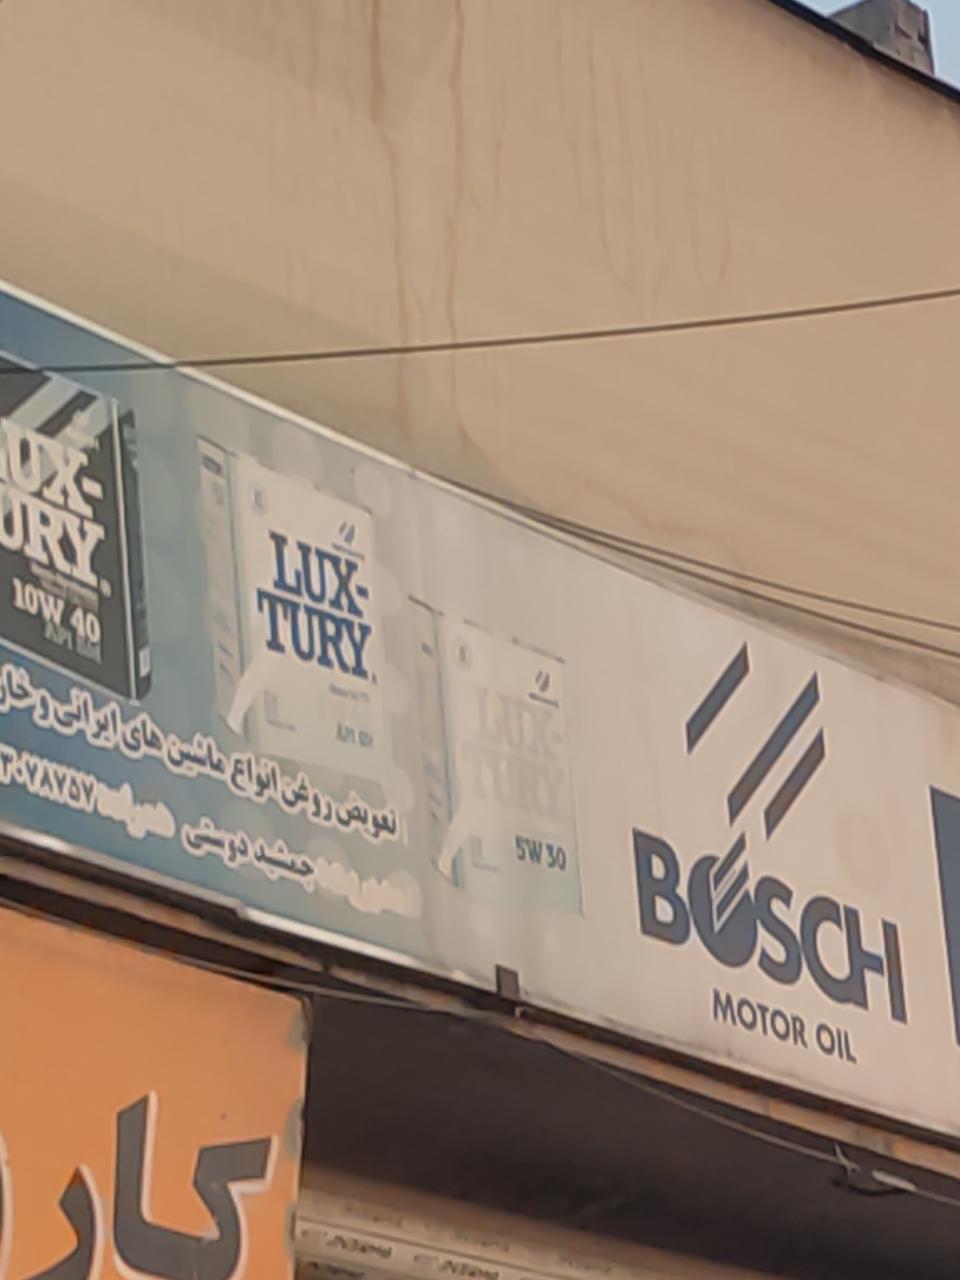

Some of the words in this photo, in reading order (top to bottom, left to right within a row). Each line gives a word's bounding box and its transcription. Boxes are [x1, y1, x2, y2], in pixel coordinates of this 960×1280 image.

[0, 419, 104, 520] UX-
[70, 606, 101, 644] 40
[229, 755, 280, 798] انواع
[545, 843, 567, 872] 30
[632, 827, 908, 1026] BOSCH
[712, 987, 808, 1048] MOTOR
[815, 1022, 857, 1065] OIL
